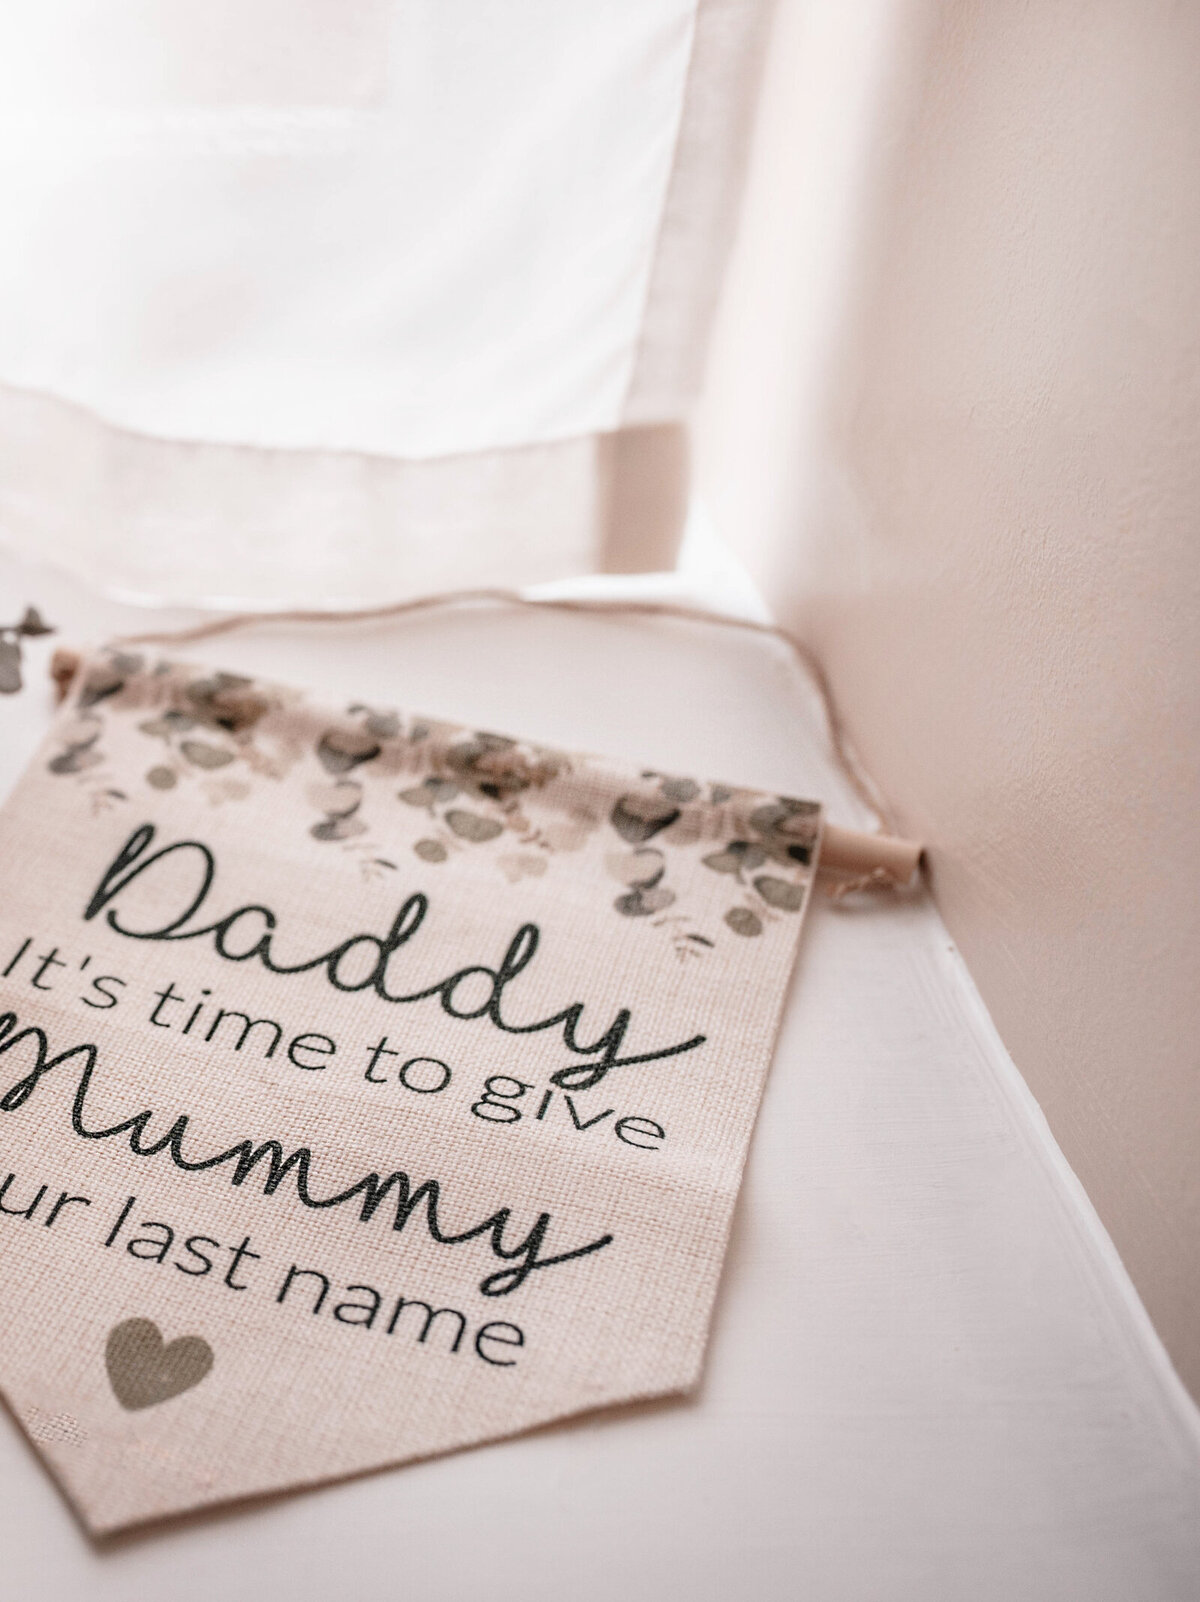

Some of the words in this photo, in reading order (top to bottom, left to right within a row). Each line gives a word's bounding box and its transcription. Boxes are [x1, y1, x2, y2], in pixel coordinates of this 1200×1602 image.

[2, 938, 128, 1011] It's
[149, 982, 338, 1073] time
[363, 1036, 453, 1095] to
[470, 1075, 667, 1152] give
[83, 823, 708, 1091] Daddy
[103, 1196, 262, 1292] last
[275, 1263, 526, 1368] name
